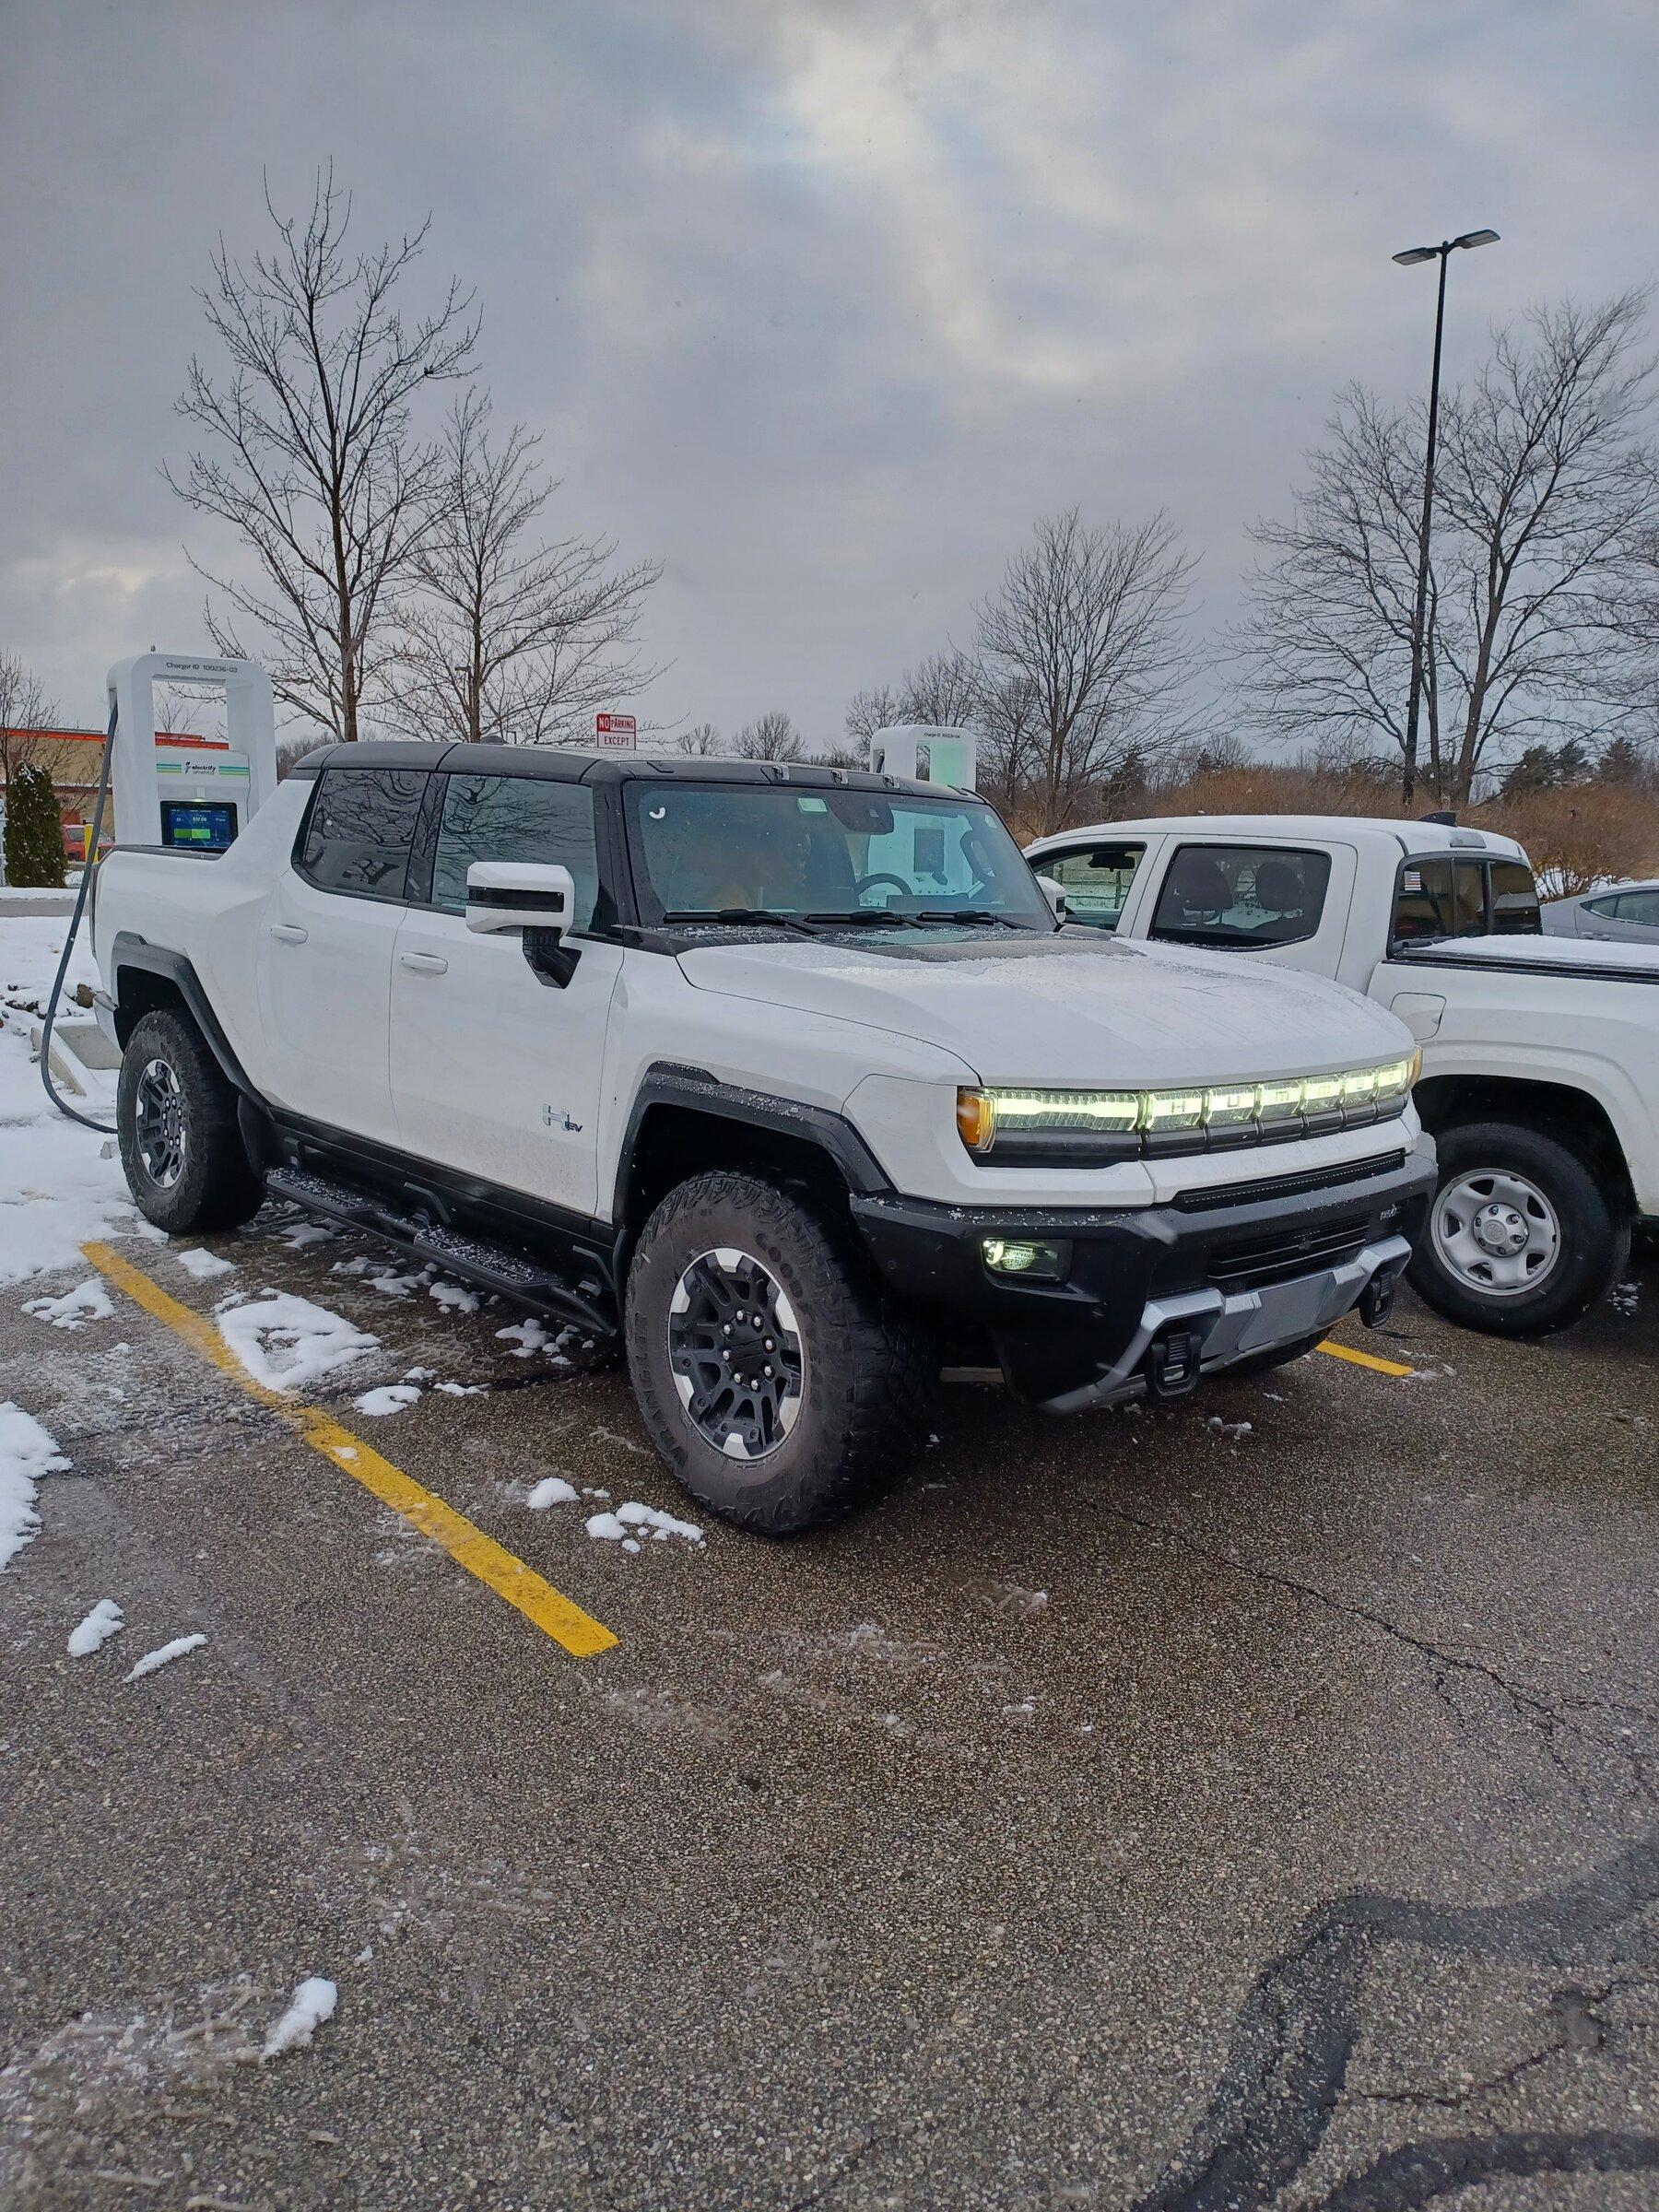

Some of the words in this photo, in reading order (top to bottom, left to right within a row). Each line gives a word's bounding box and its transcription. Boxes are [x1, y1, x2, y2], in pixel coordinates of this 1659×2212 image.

[166, 662, 191, 670] Charger
[599, 716, 609, 729] NO
[611, 718, 633, 729] PARKING
[604, 736, 629, 746] EXCEPT
